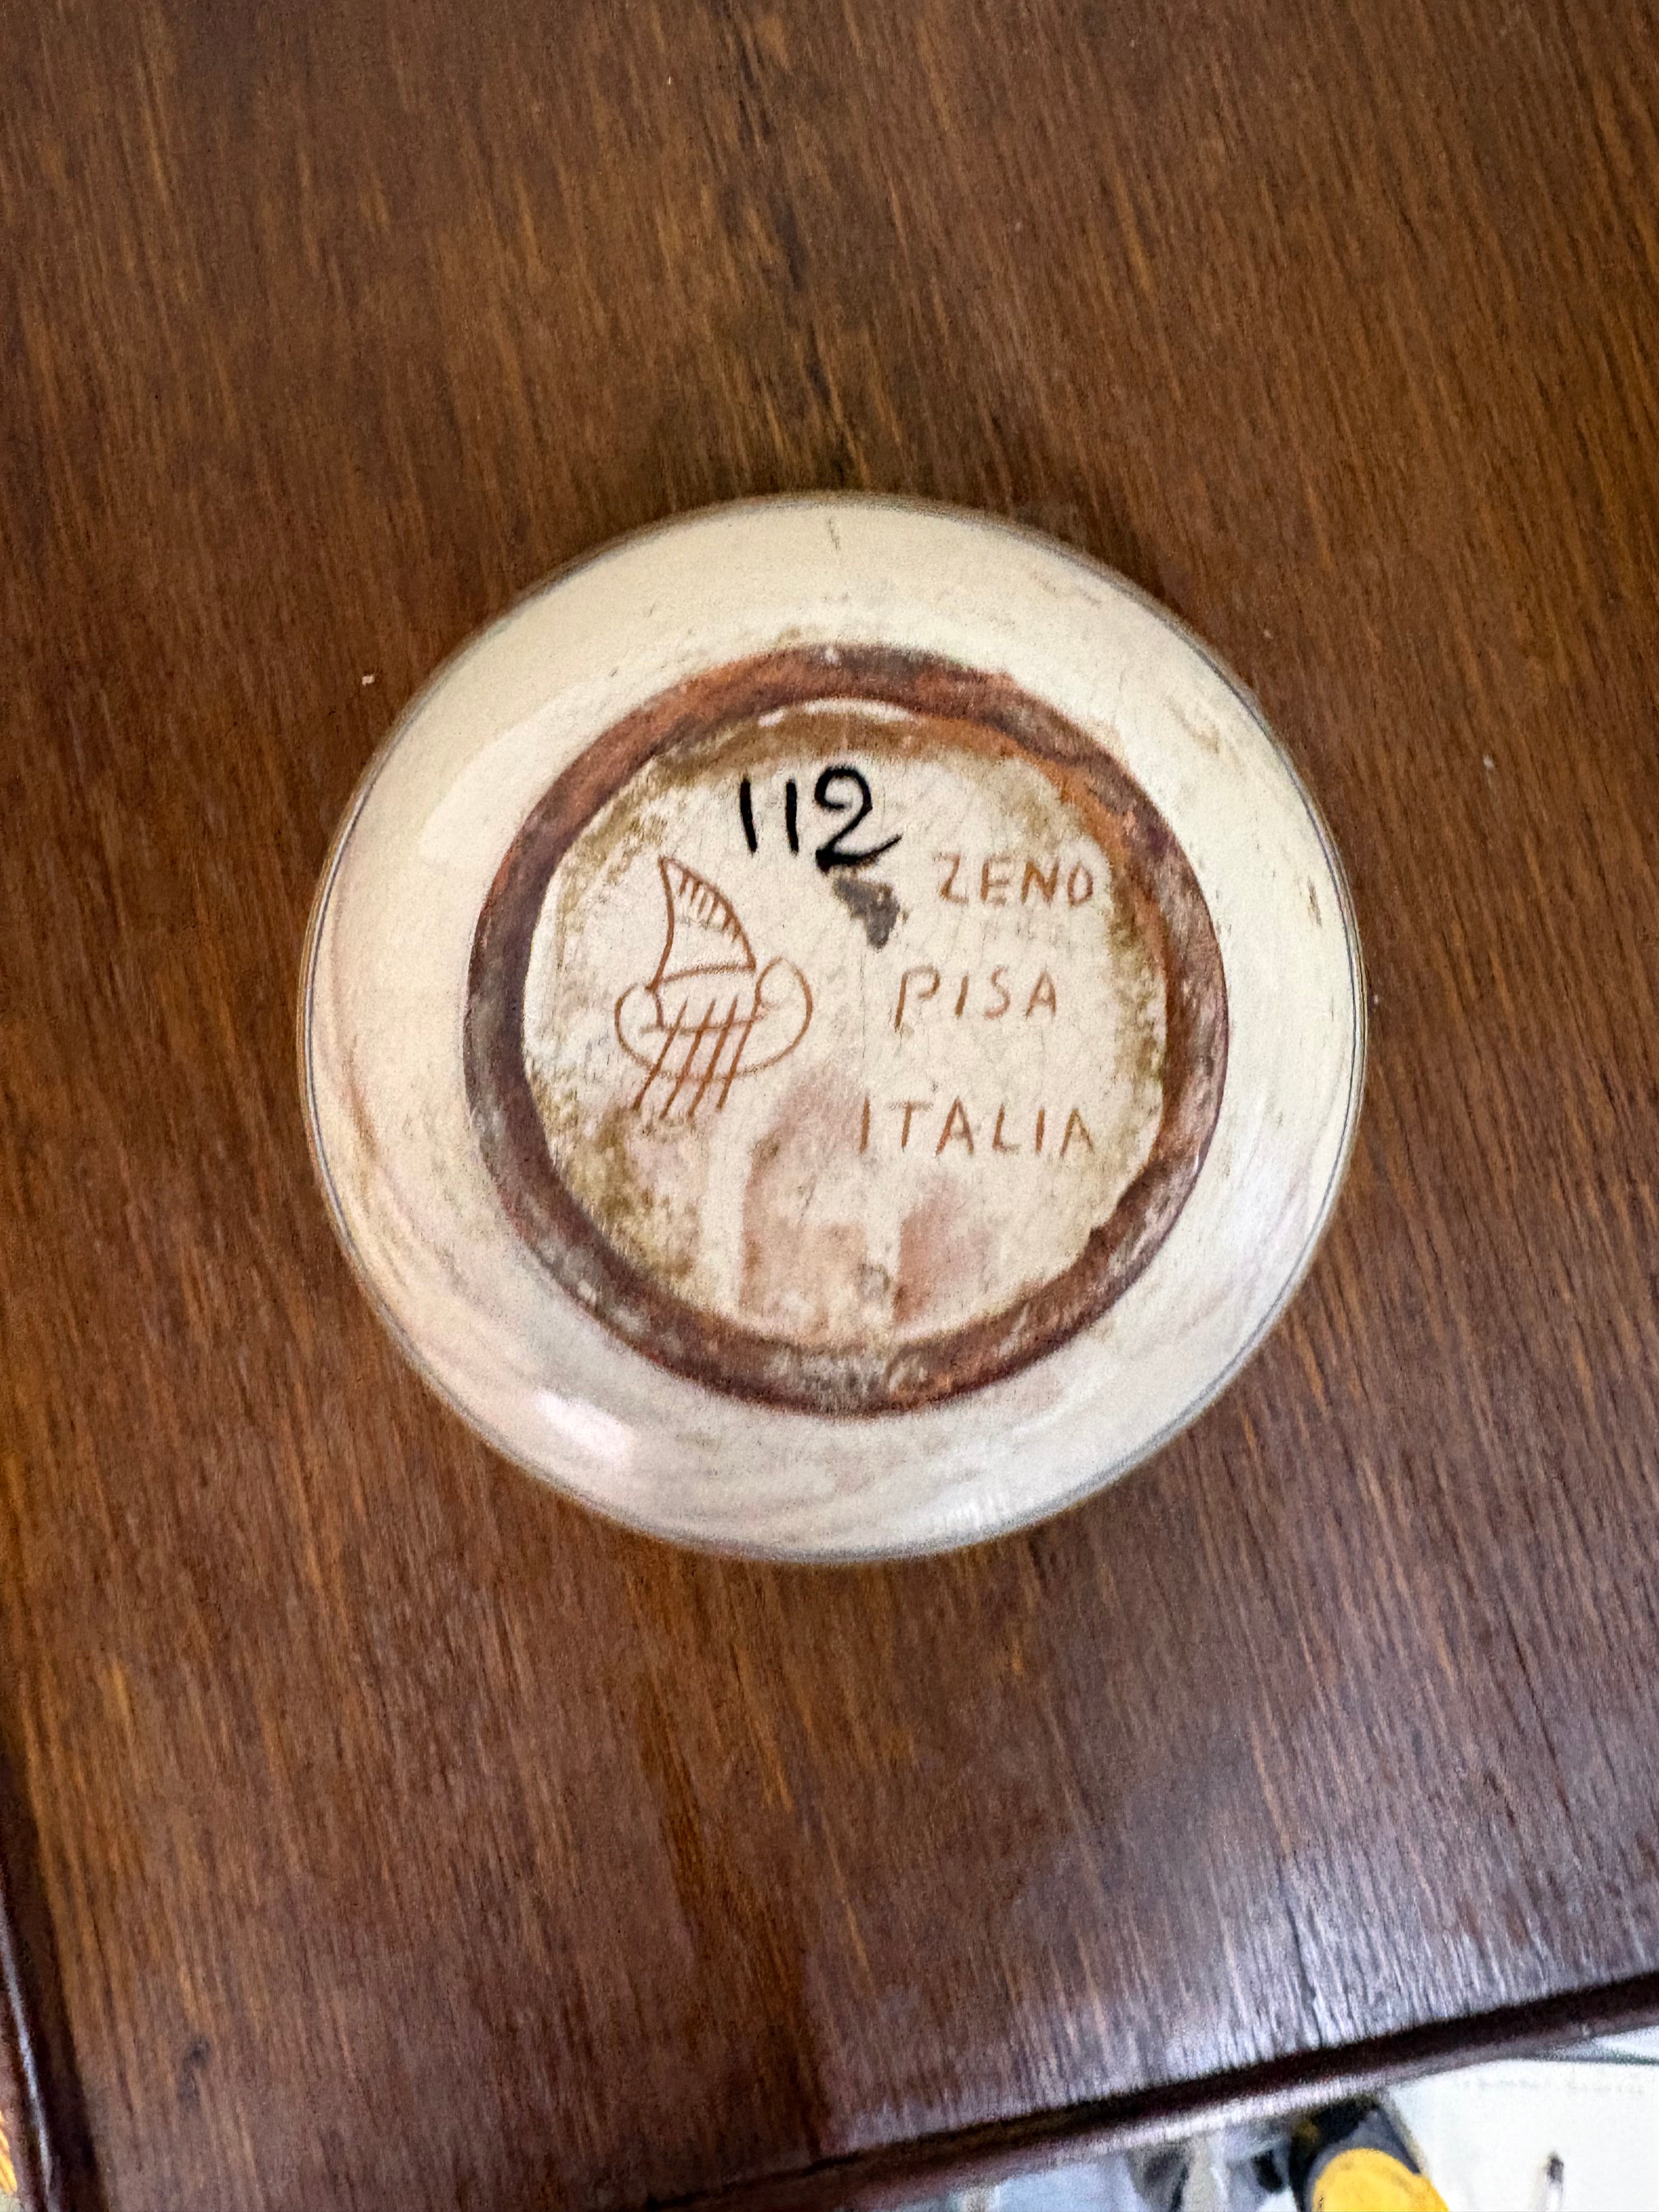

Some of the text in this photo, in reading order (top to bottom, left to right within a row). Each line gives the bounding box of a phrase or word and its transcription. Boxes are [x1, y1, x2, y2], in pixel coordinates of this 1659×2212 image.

[739, 764, 902, 874] 112
[936, 851, 1094, 908] ZENO
[894, 964, 1057, 1030] PISA
[859, 1098, 1093, 1158] ITALIA
